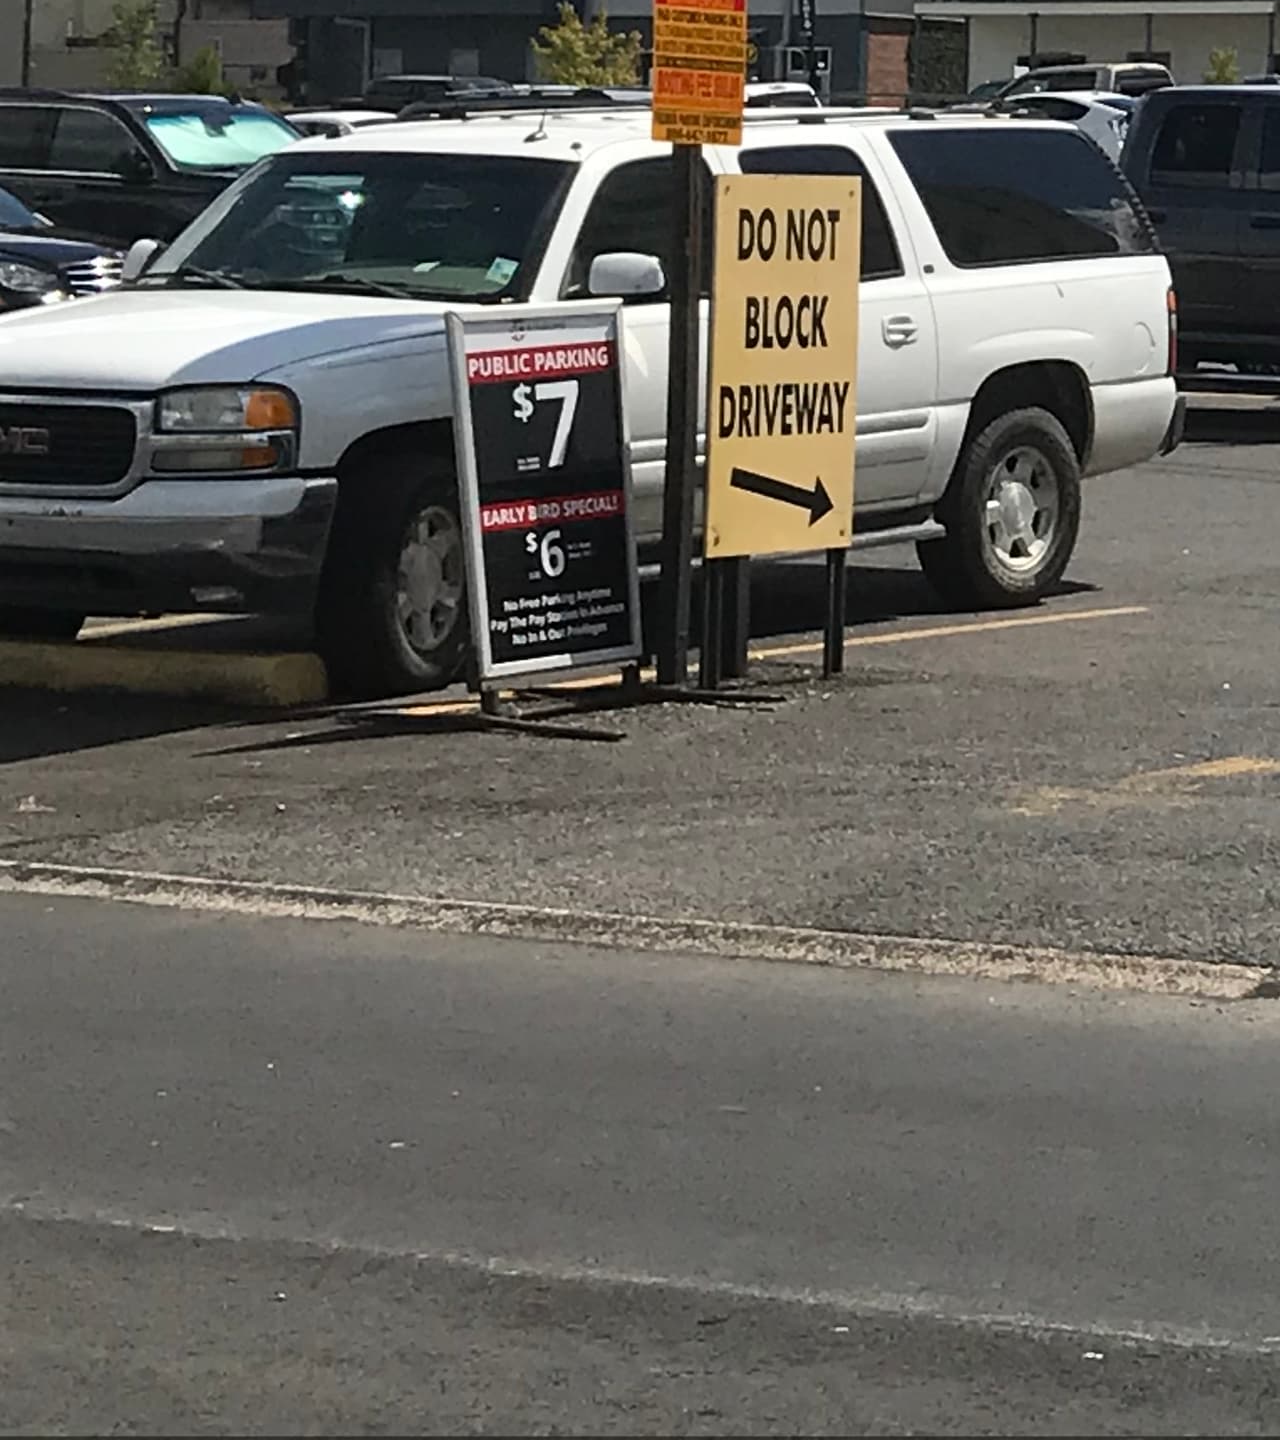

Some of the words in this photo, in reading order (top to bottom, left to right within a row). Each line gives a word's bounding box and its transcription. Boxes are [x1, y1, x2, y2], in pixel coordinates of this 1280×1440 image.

[738, 208, 777, 262] DO
[786, 208, 841, 261] NOT
[745, 295, 829, 349] BLOCK
[468, 352, 531, 378] PUBLIC
[534, 346, 609, 372] PARKING
[512, 380, 580, 468] $7
[719, 382, 850, 438] DRIVEWAY
[0, 426, 49, 454] MC
[483, 509, 526, 528] EARLY
[528, 503, 561, 521] BIRD
[563, 495, 618, 516] SPECIAL!
[525, 529, 565, 578] $6
